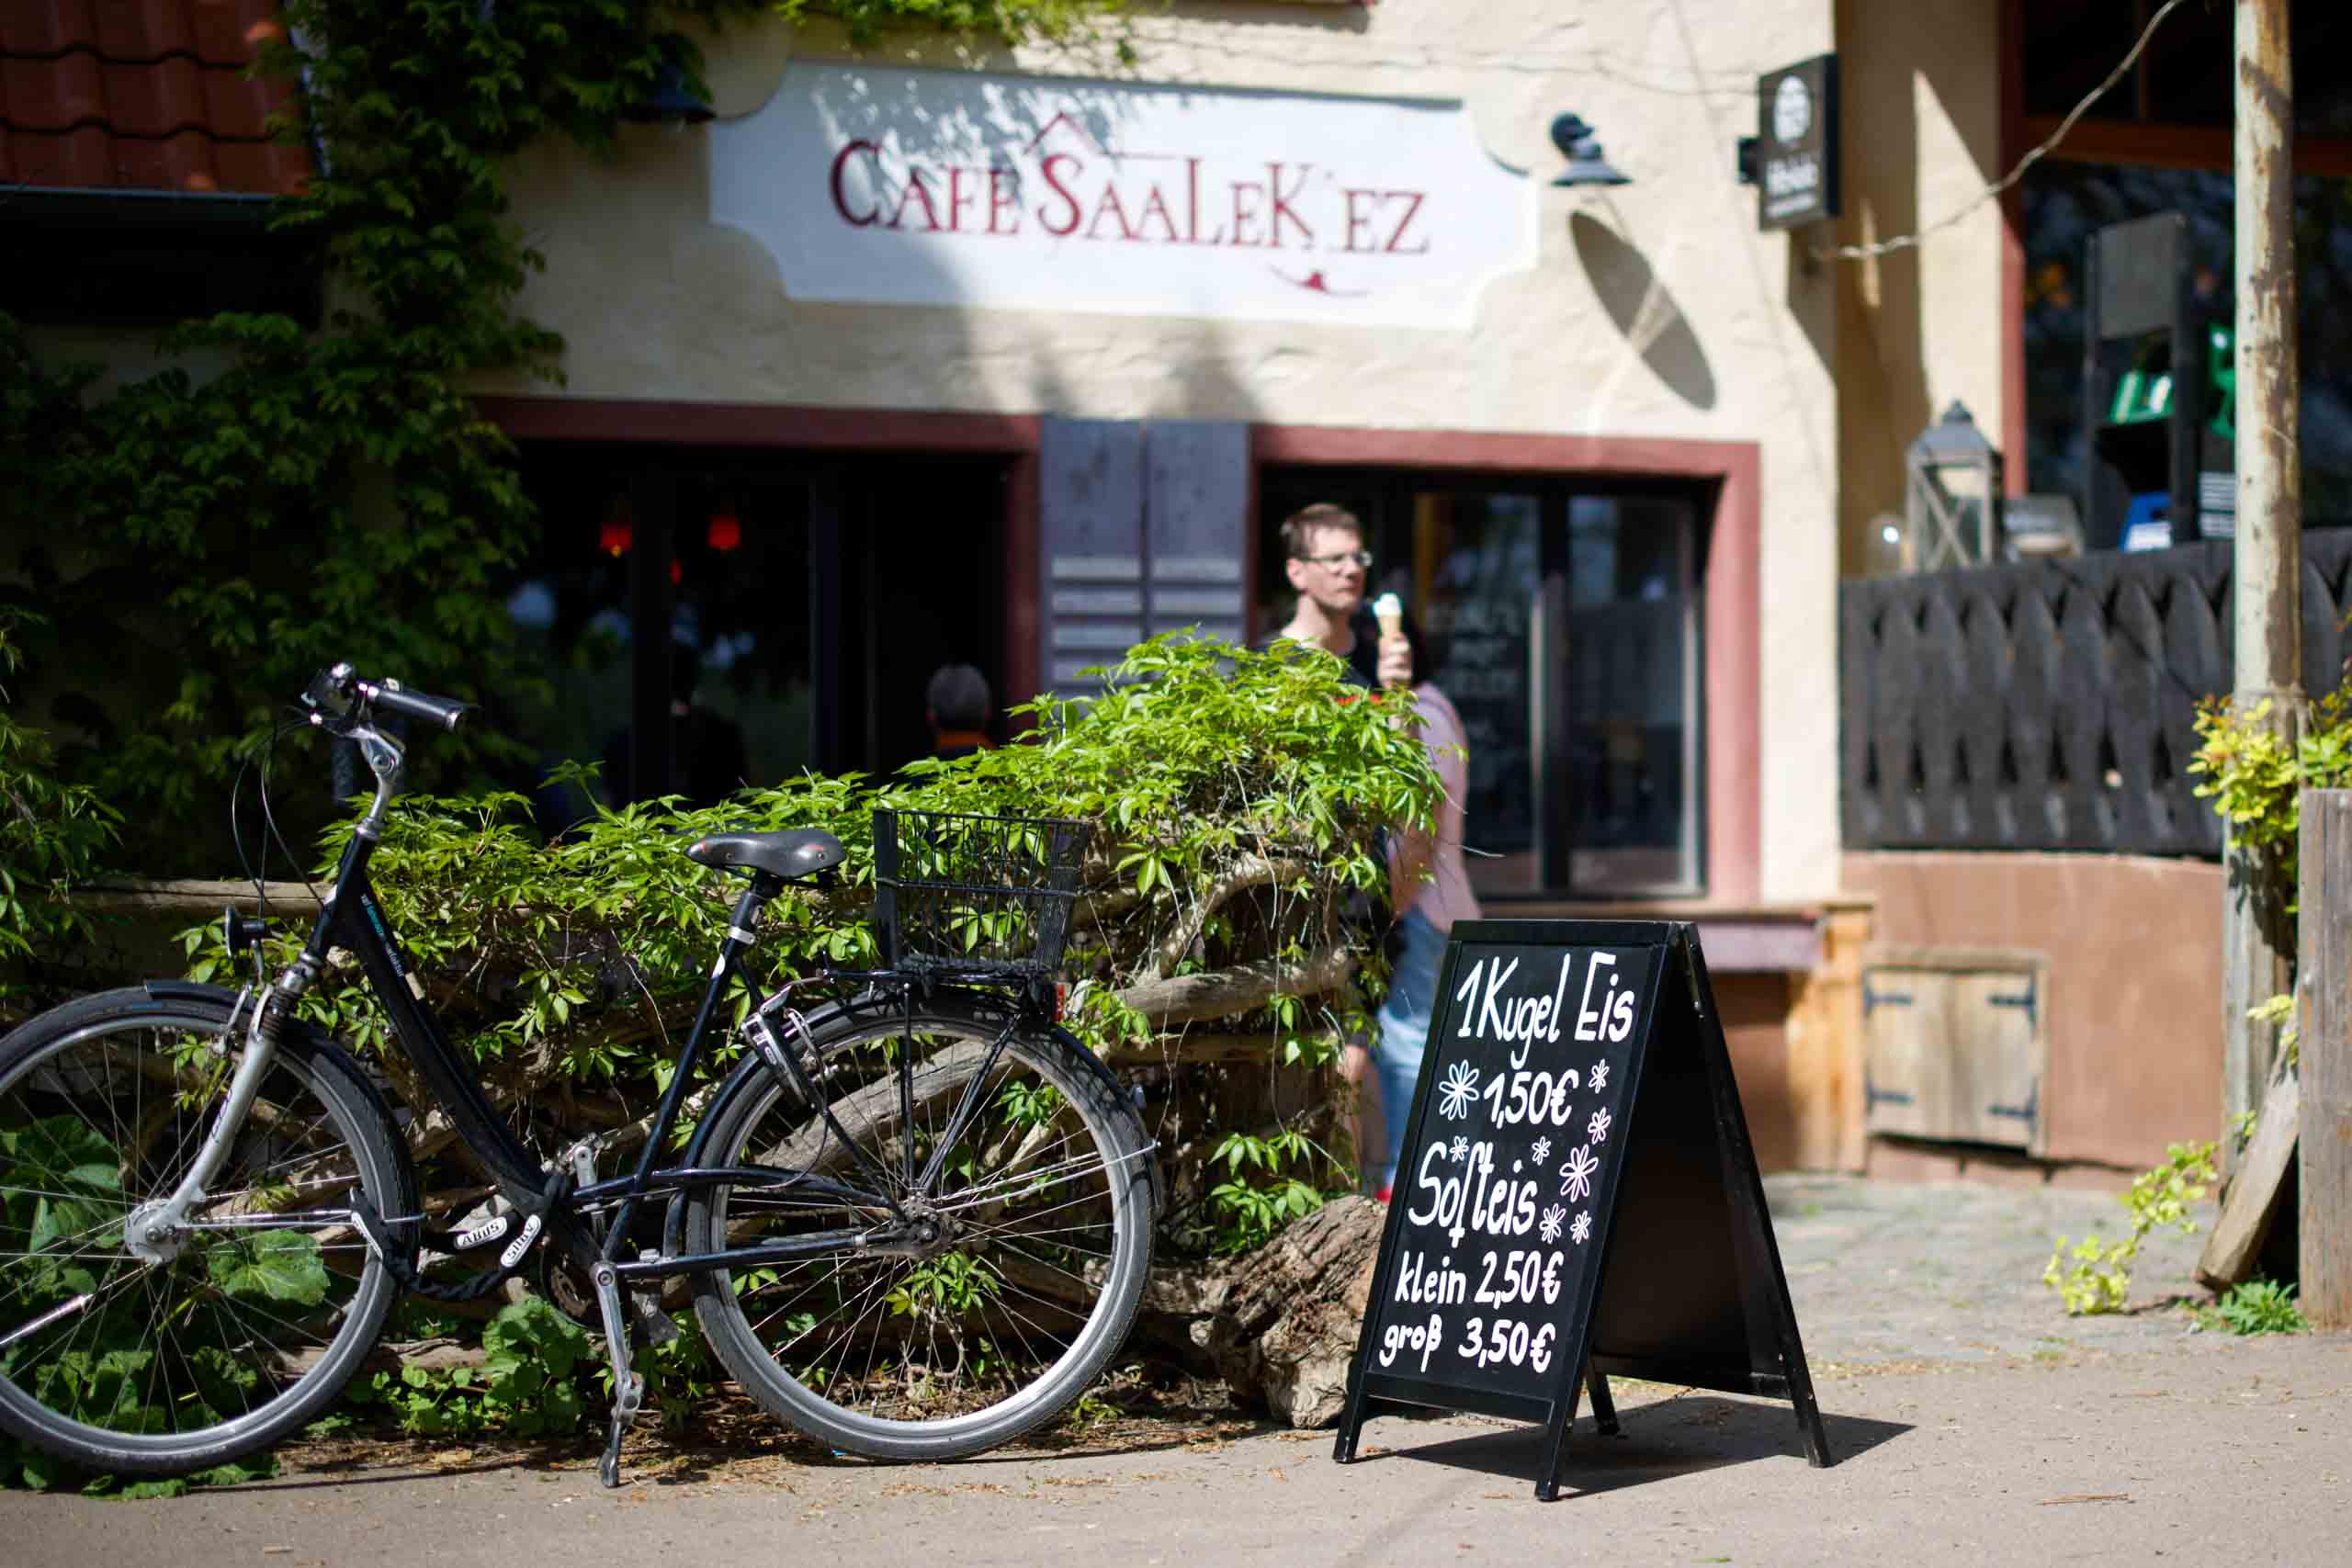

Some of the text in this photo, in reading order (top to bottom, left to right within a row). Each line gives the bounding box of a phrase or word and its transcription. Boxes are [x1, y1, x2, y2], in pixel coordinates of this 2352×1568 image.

[830, 138, 1430, 256] CAFE SAALEKEZ
[1476, 955, 1572, 1071] Kugel
[1574, 951, 1635, 1043] Eis
[1484, 1068, 1579, 1130] 1,50€
[1408, 1141, 1538, 1248] Softeis
[462, 1222, 499, 1245] ABUS
[1395, 1250, 1565, 1310] klein 2,50€
[1379, 1314, 1555, 1373] groß 3,50€
